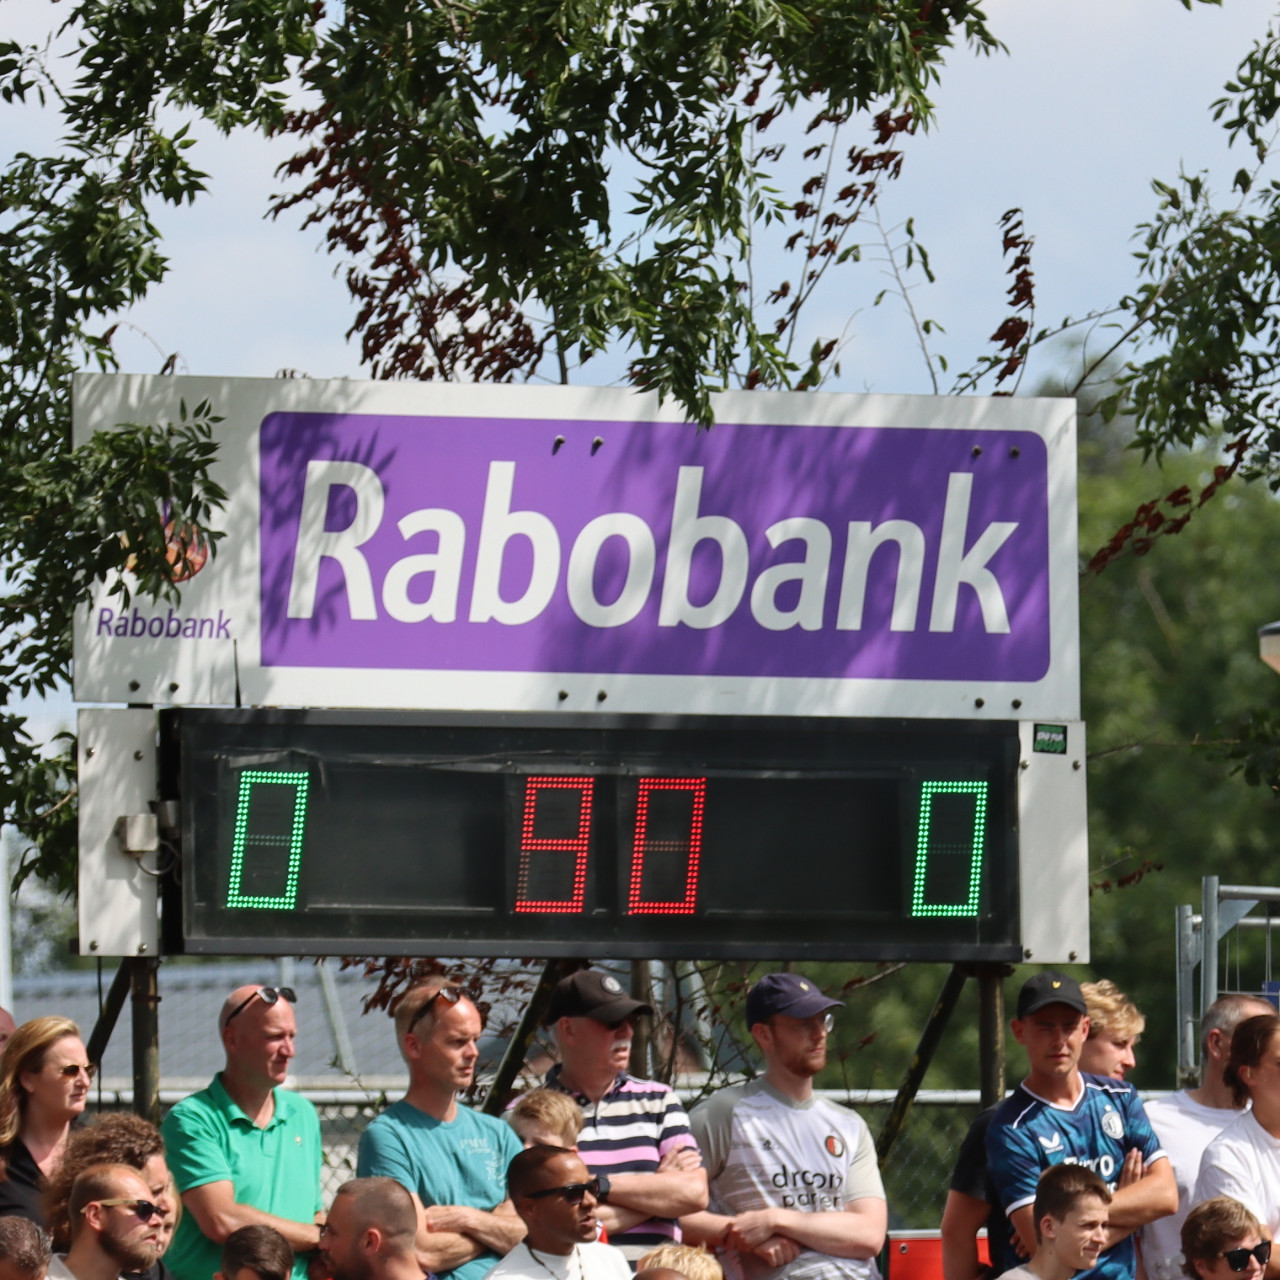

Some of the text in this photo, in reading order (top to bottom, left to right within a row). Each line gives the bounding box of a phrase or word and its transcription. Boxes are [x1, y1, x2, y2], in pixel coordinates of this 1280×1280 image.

[286, 459, 1020, 634] Rabobank
[96, 607, 232, 640] Rabobank
[227, 771, 988, 916] 0 90 0
